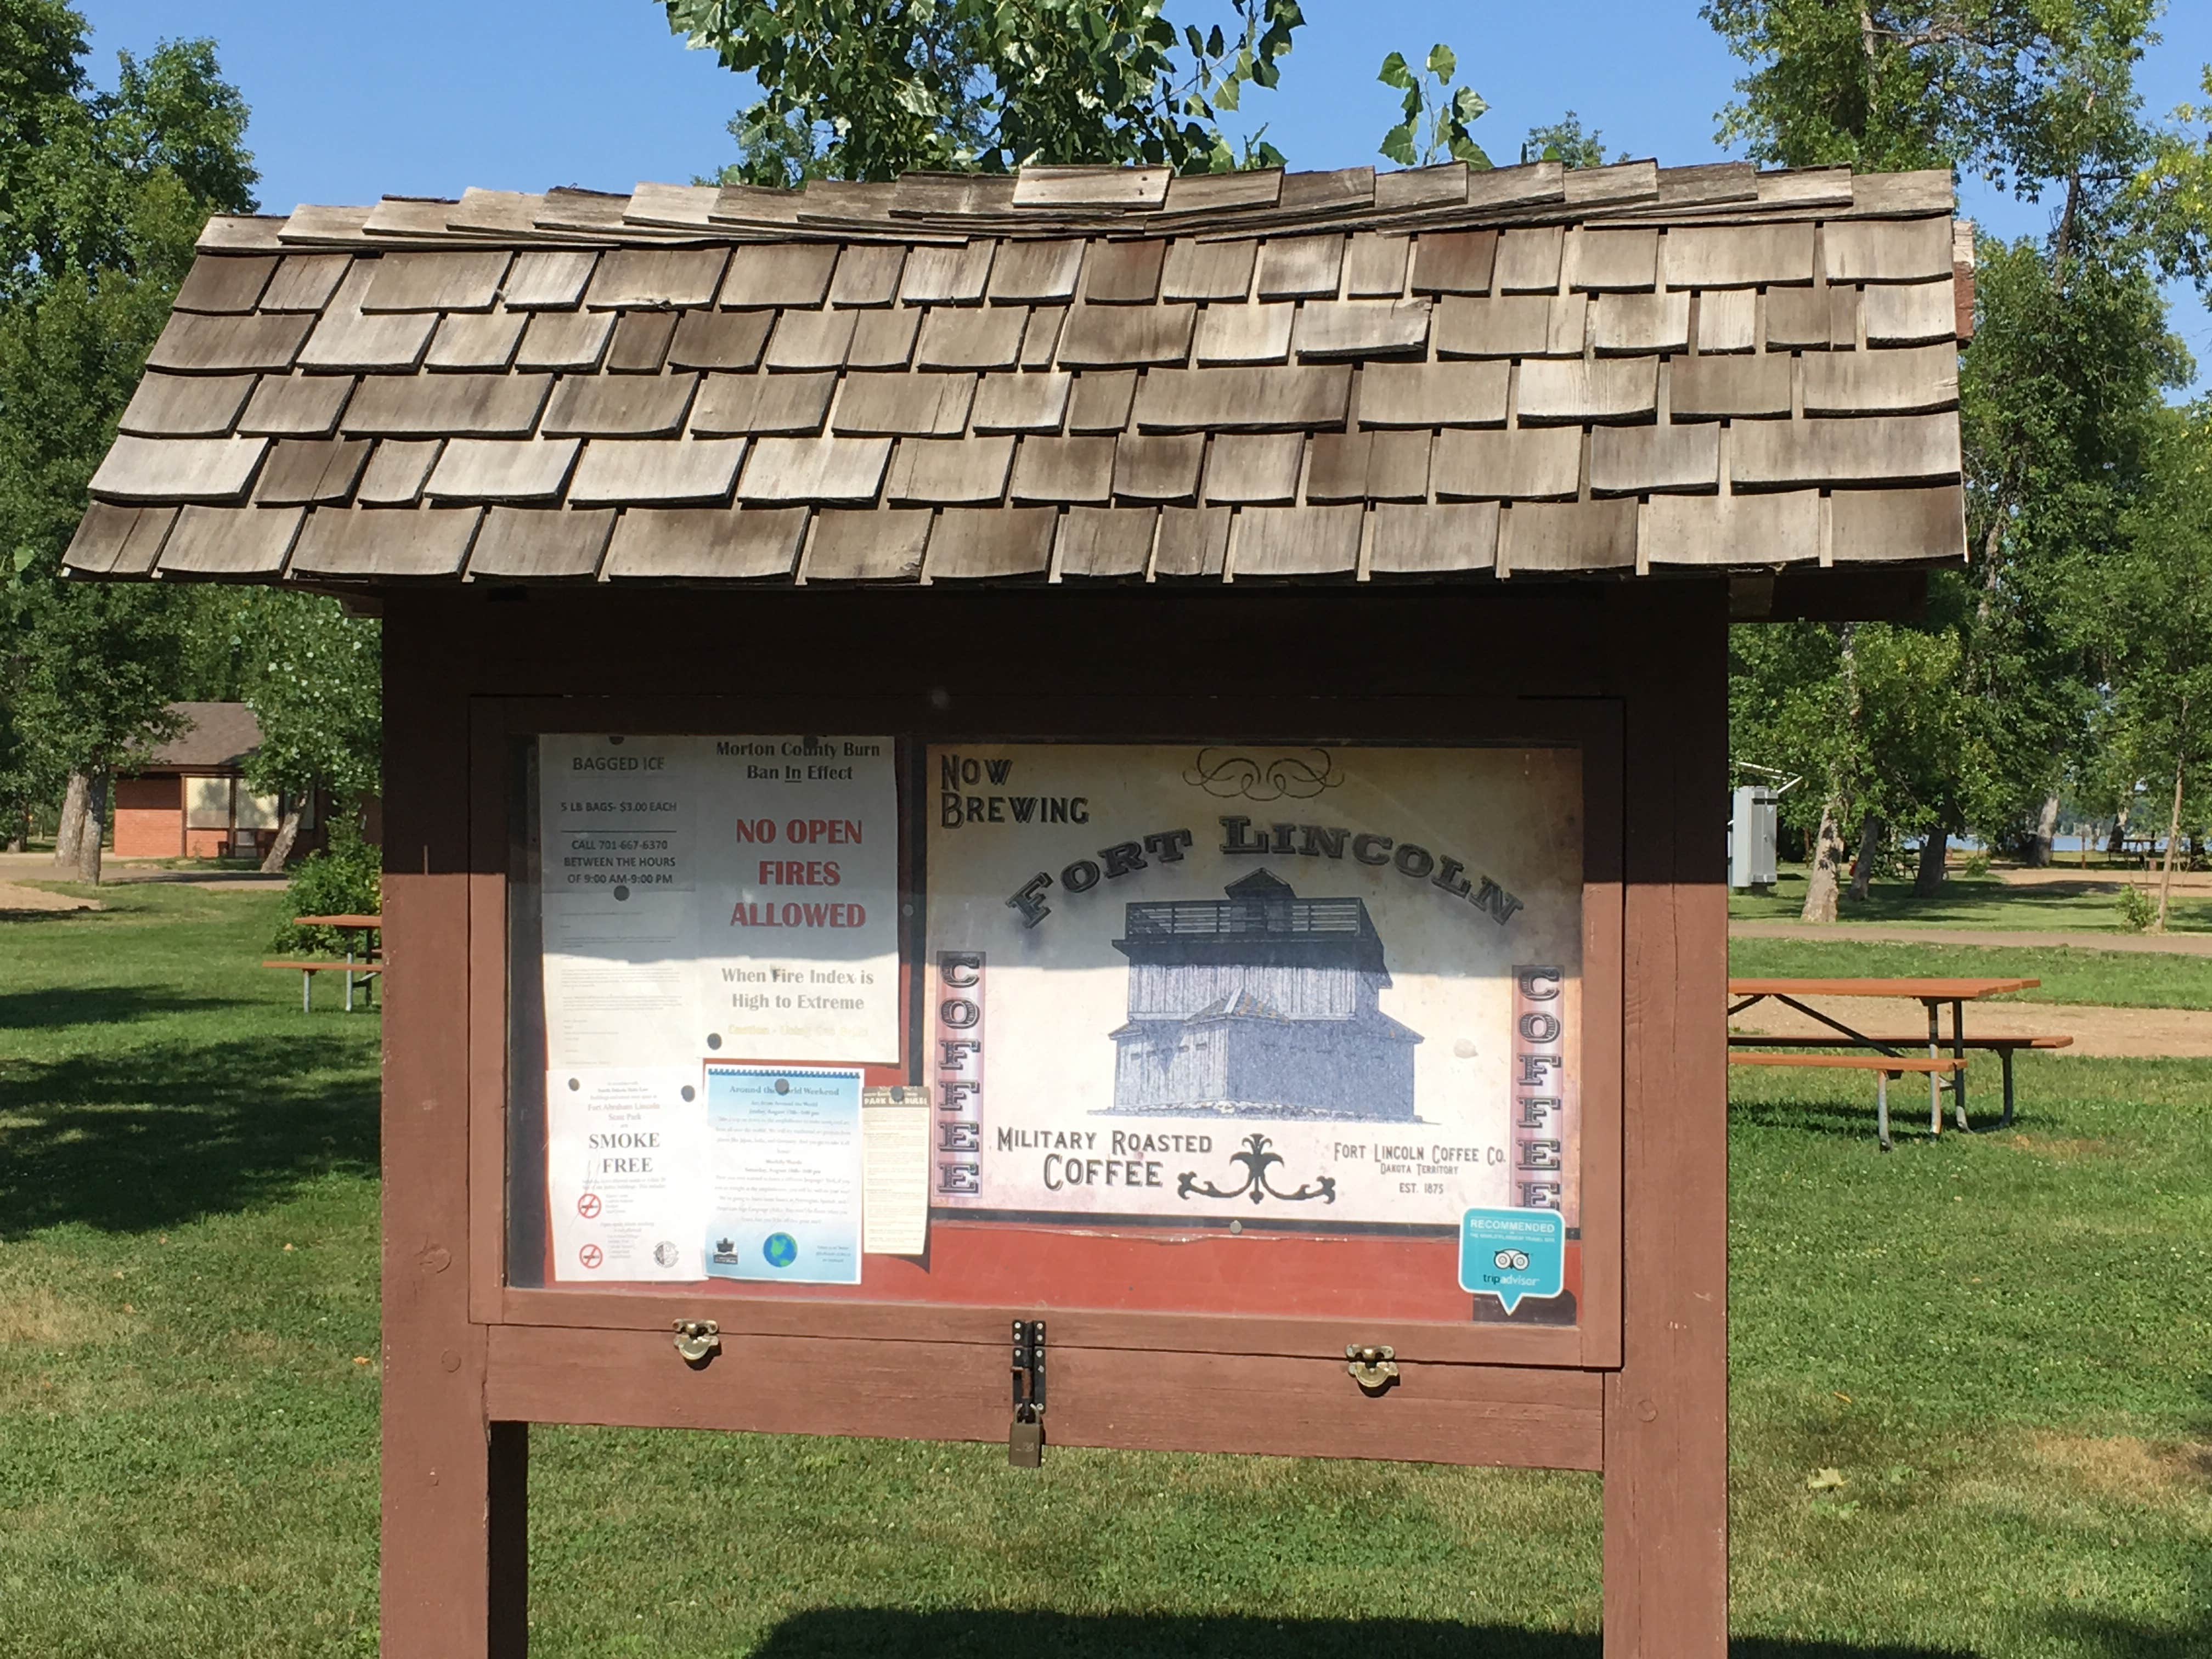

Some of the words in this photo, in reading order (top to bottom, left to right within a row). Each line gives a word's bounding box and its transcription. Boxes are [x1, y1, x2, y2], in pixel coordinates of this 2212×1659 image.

[716, 742, 775, 756] Morton
[844, 742, 880, 757] Burn
[573, 757, 639, 770] BAGGED
[644, 757, 664, 770] ICE
[747, 765, 778, 780] Ban
[785, 765, 802, 781] In
[808, 765, 853, 780] Effect
[941, 754, 1013, 791] NOW
[571, 802, 583, 812] LB
[619, 801, 647, 812] $3.00
[649, 802, 677, 812] EACH
[941, 792, 1090, 829] BREWING
[736, 819, 776, 844] NO
[786, 819, 862, 844] OPEN
[572, 840, 595, 850] CALL
[617, 857, 636, 867] THE
[639, 857, 676, 867] HOURS
[567, 874, 581, 884] OF
[656, 874, 673, 884] PM
[759, 860, 840, 886] FIRES
[1005, 827, 1193, 929] FORT
[1218, 815, 1525, 926] LINCOLN
[730, 902, 866, 928] ALLOWED
[721, 968, 766, 983] When
[771, 968, 804, 984] Fire
[810, 969, 856, 984] Index
[860, 969, 874, 984] is
[732, 993, 769, 1011] High
[775, 994, 791, 1008] to
[797, 994, 865, 1009] Extreme
[937, 957, 981, 1194] COFFEE
[1515, 967, 1562, 1208] COFFEE
[589, 1132, 660, 1149] SMOKE
[997, 1126, 1097, 1152] MILITARY
[1111, 1130, 1212, 1155] ROASTED
[1334, 1142, 1367, 1161] FORT
[1374, 1143, 1424, 1163] LINCOLN
[1432, 1144, 1480, 1164] COFFEE
[602, 1157, 653, 1173] FREE
[1043, 1153, 1164, 1192] COFFEE
[1380, 1163, 1412, 1175] DAKOTA
[1417, 1163, 1459, 1176] TERRITORY
[1399, 1182, 1419, 1194] EST.
[1424, 1183, 1444, 1194] 1875
[1470, 1220, 1555, 1233] RECOMMENDED
[1483, 1274, 1540, 1286] tripadvisor
